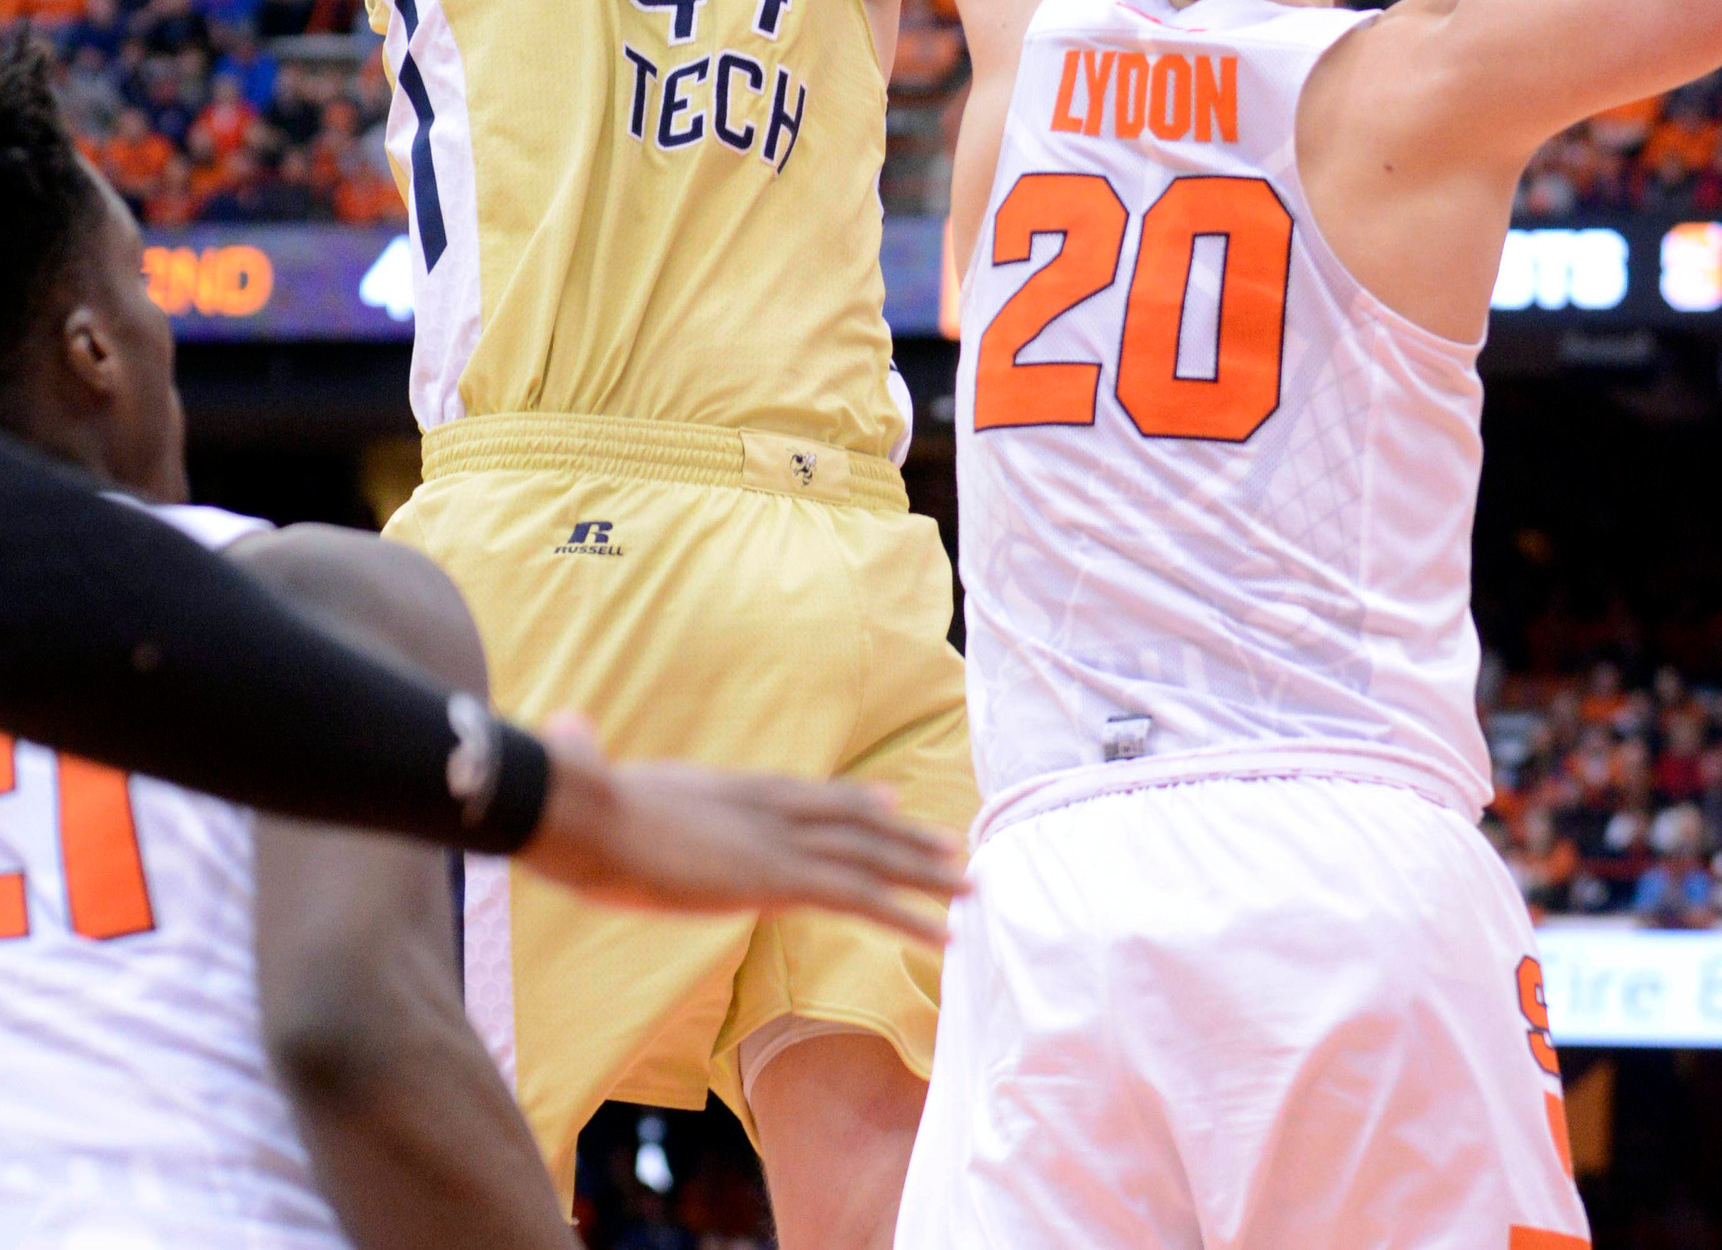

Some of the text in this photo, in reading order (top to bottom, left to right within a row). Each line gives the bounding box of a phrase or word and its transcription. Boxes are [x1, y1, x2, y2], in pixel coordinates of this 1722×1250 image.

[623, 40, 807, 176] TECH
[1050, 49, 1239, 143] LYDON
[974, 172, 1294, 444] 20
[554, 544, 624, 557] RUSSELL
